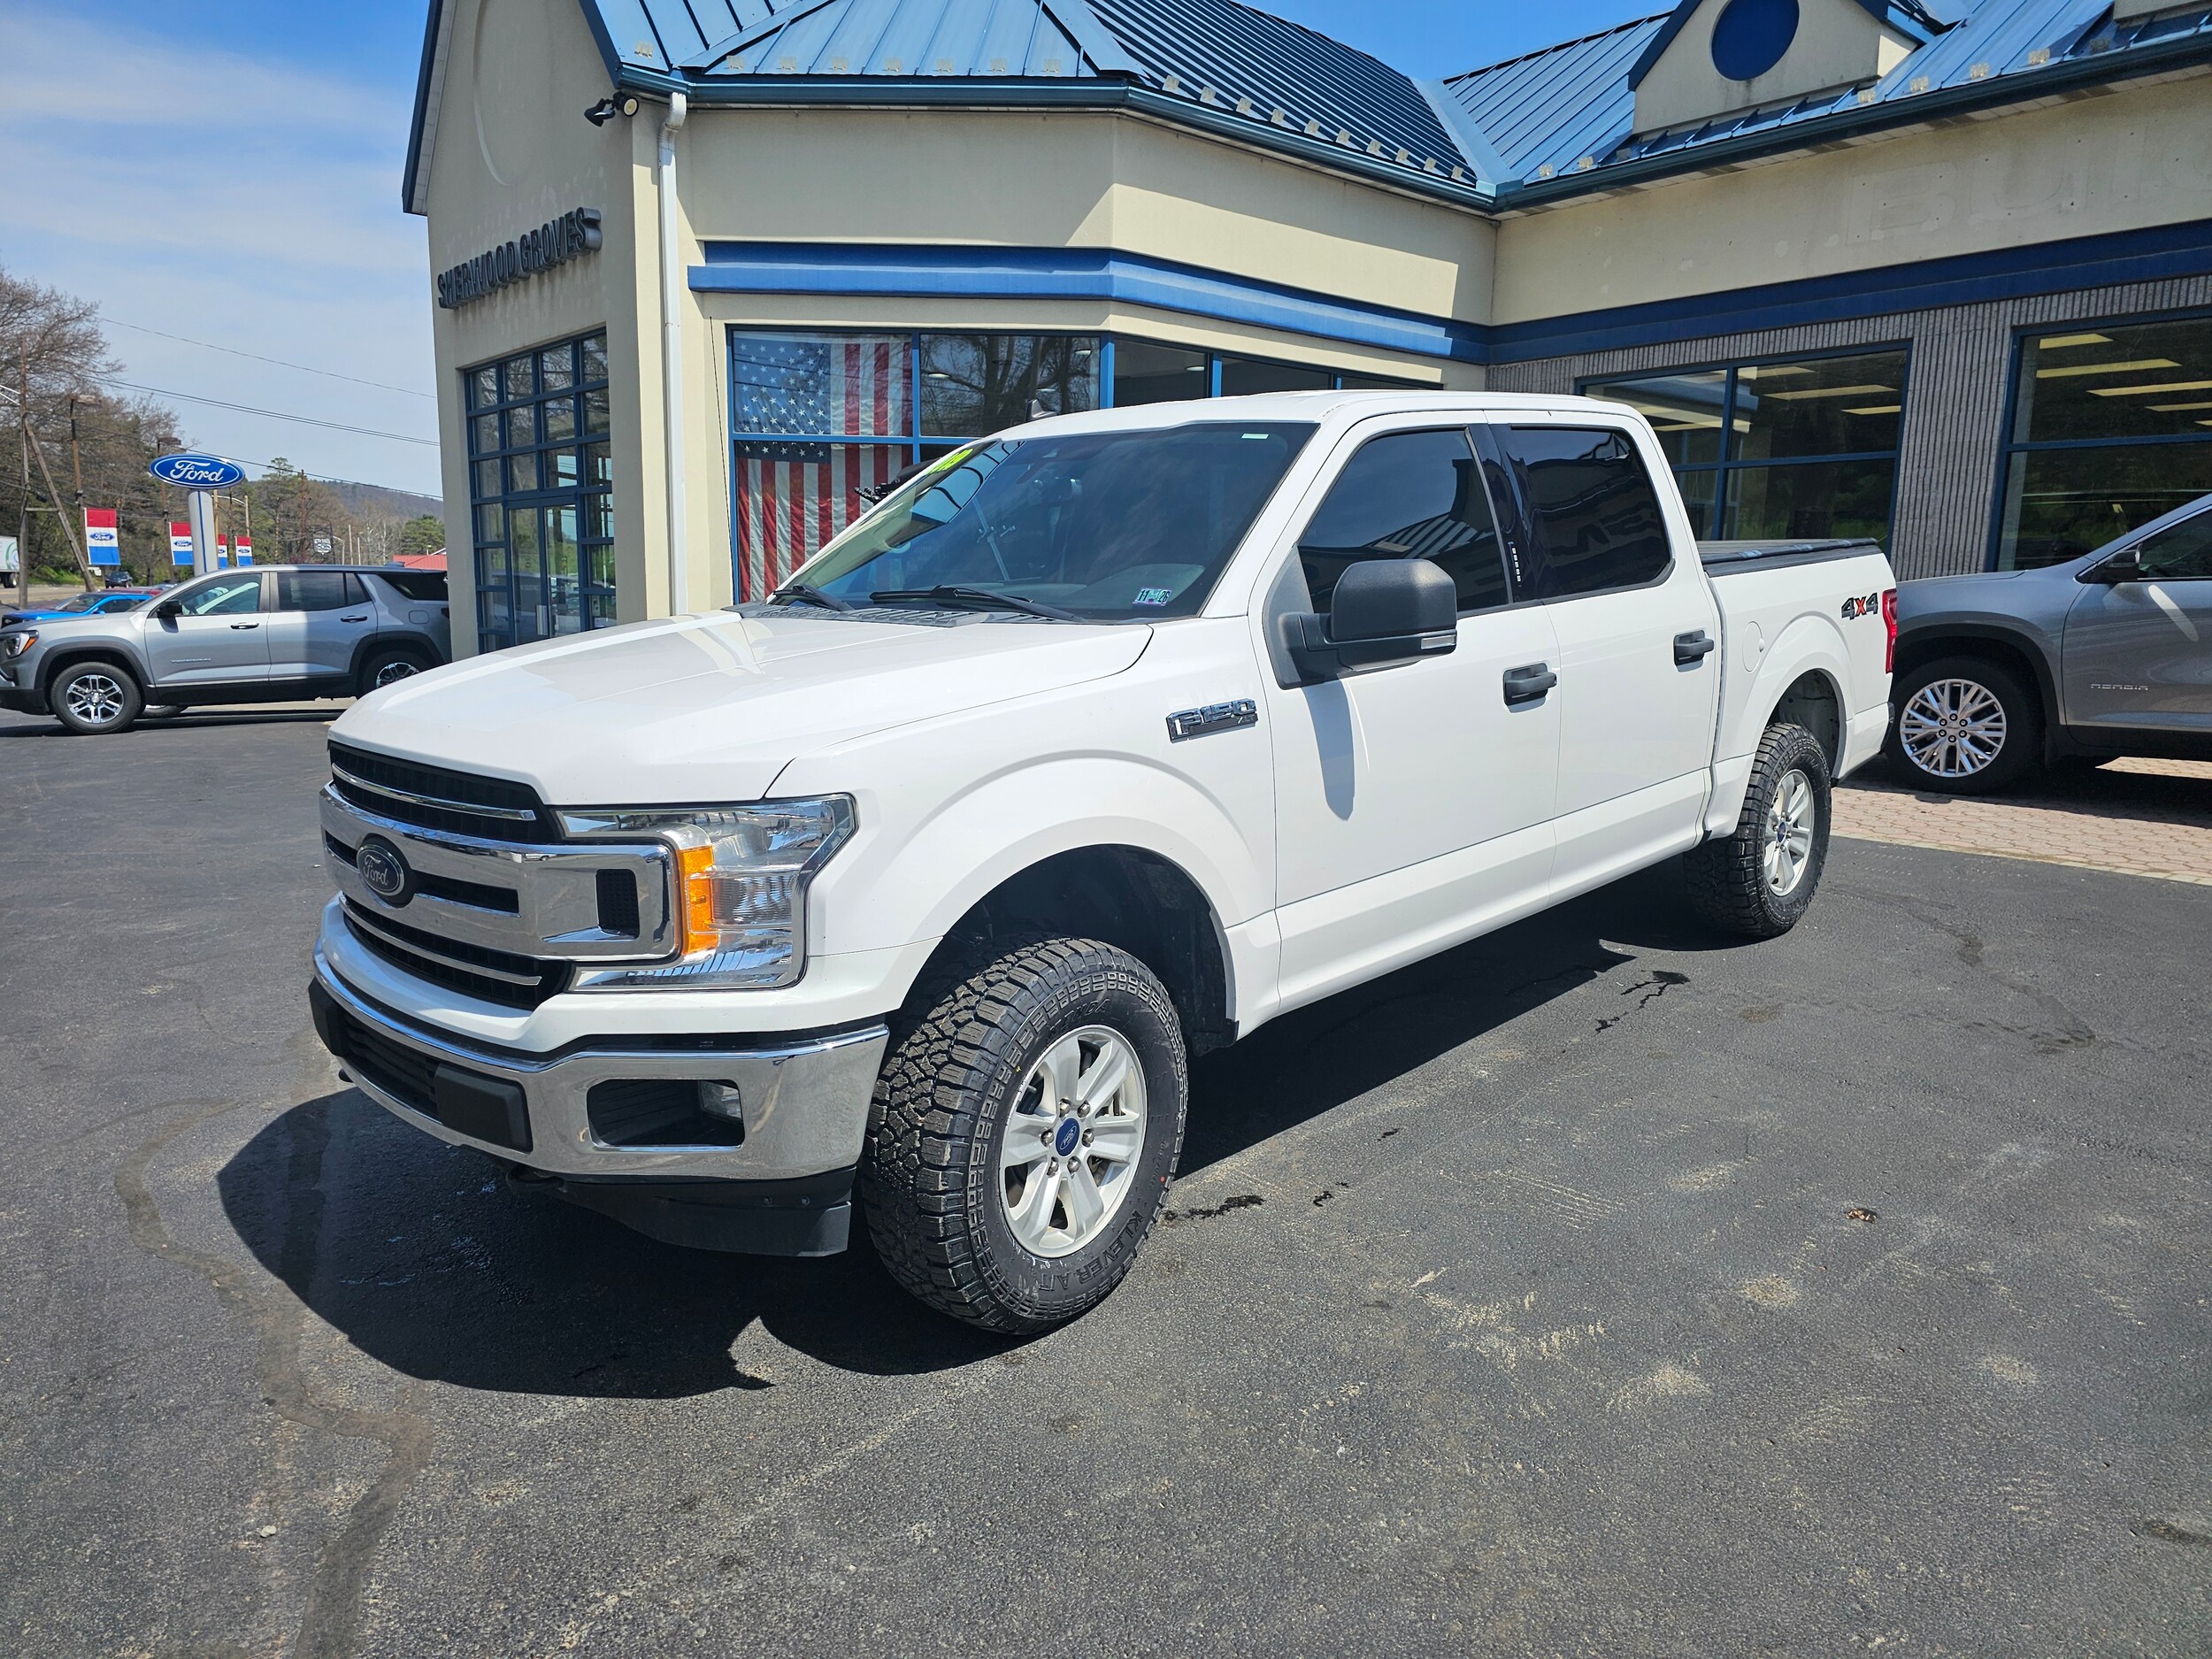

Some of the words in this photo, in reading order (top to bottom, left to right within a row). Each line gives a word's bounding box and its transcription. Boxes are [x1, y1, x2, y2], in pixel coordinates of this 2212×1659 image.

[437, 241, 519, 309] SHERWOOD
[519, 206, 603, 280] GROVES
[169, 460, 225, 482] Ford
[1138, 589, 1150, 602] 11
[363, 854, 388, 886] Ford
[1075, 1209, 1144, 1285] KLEVER
